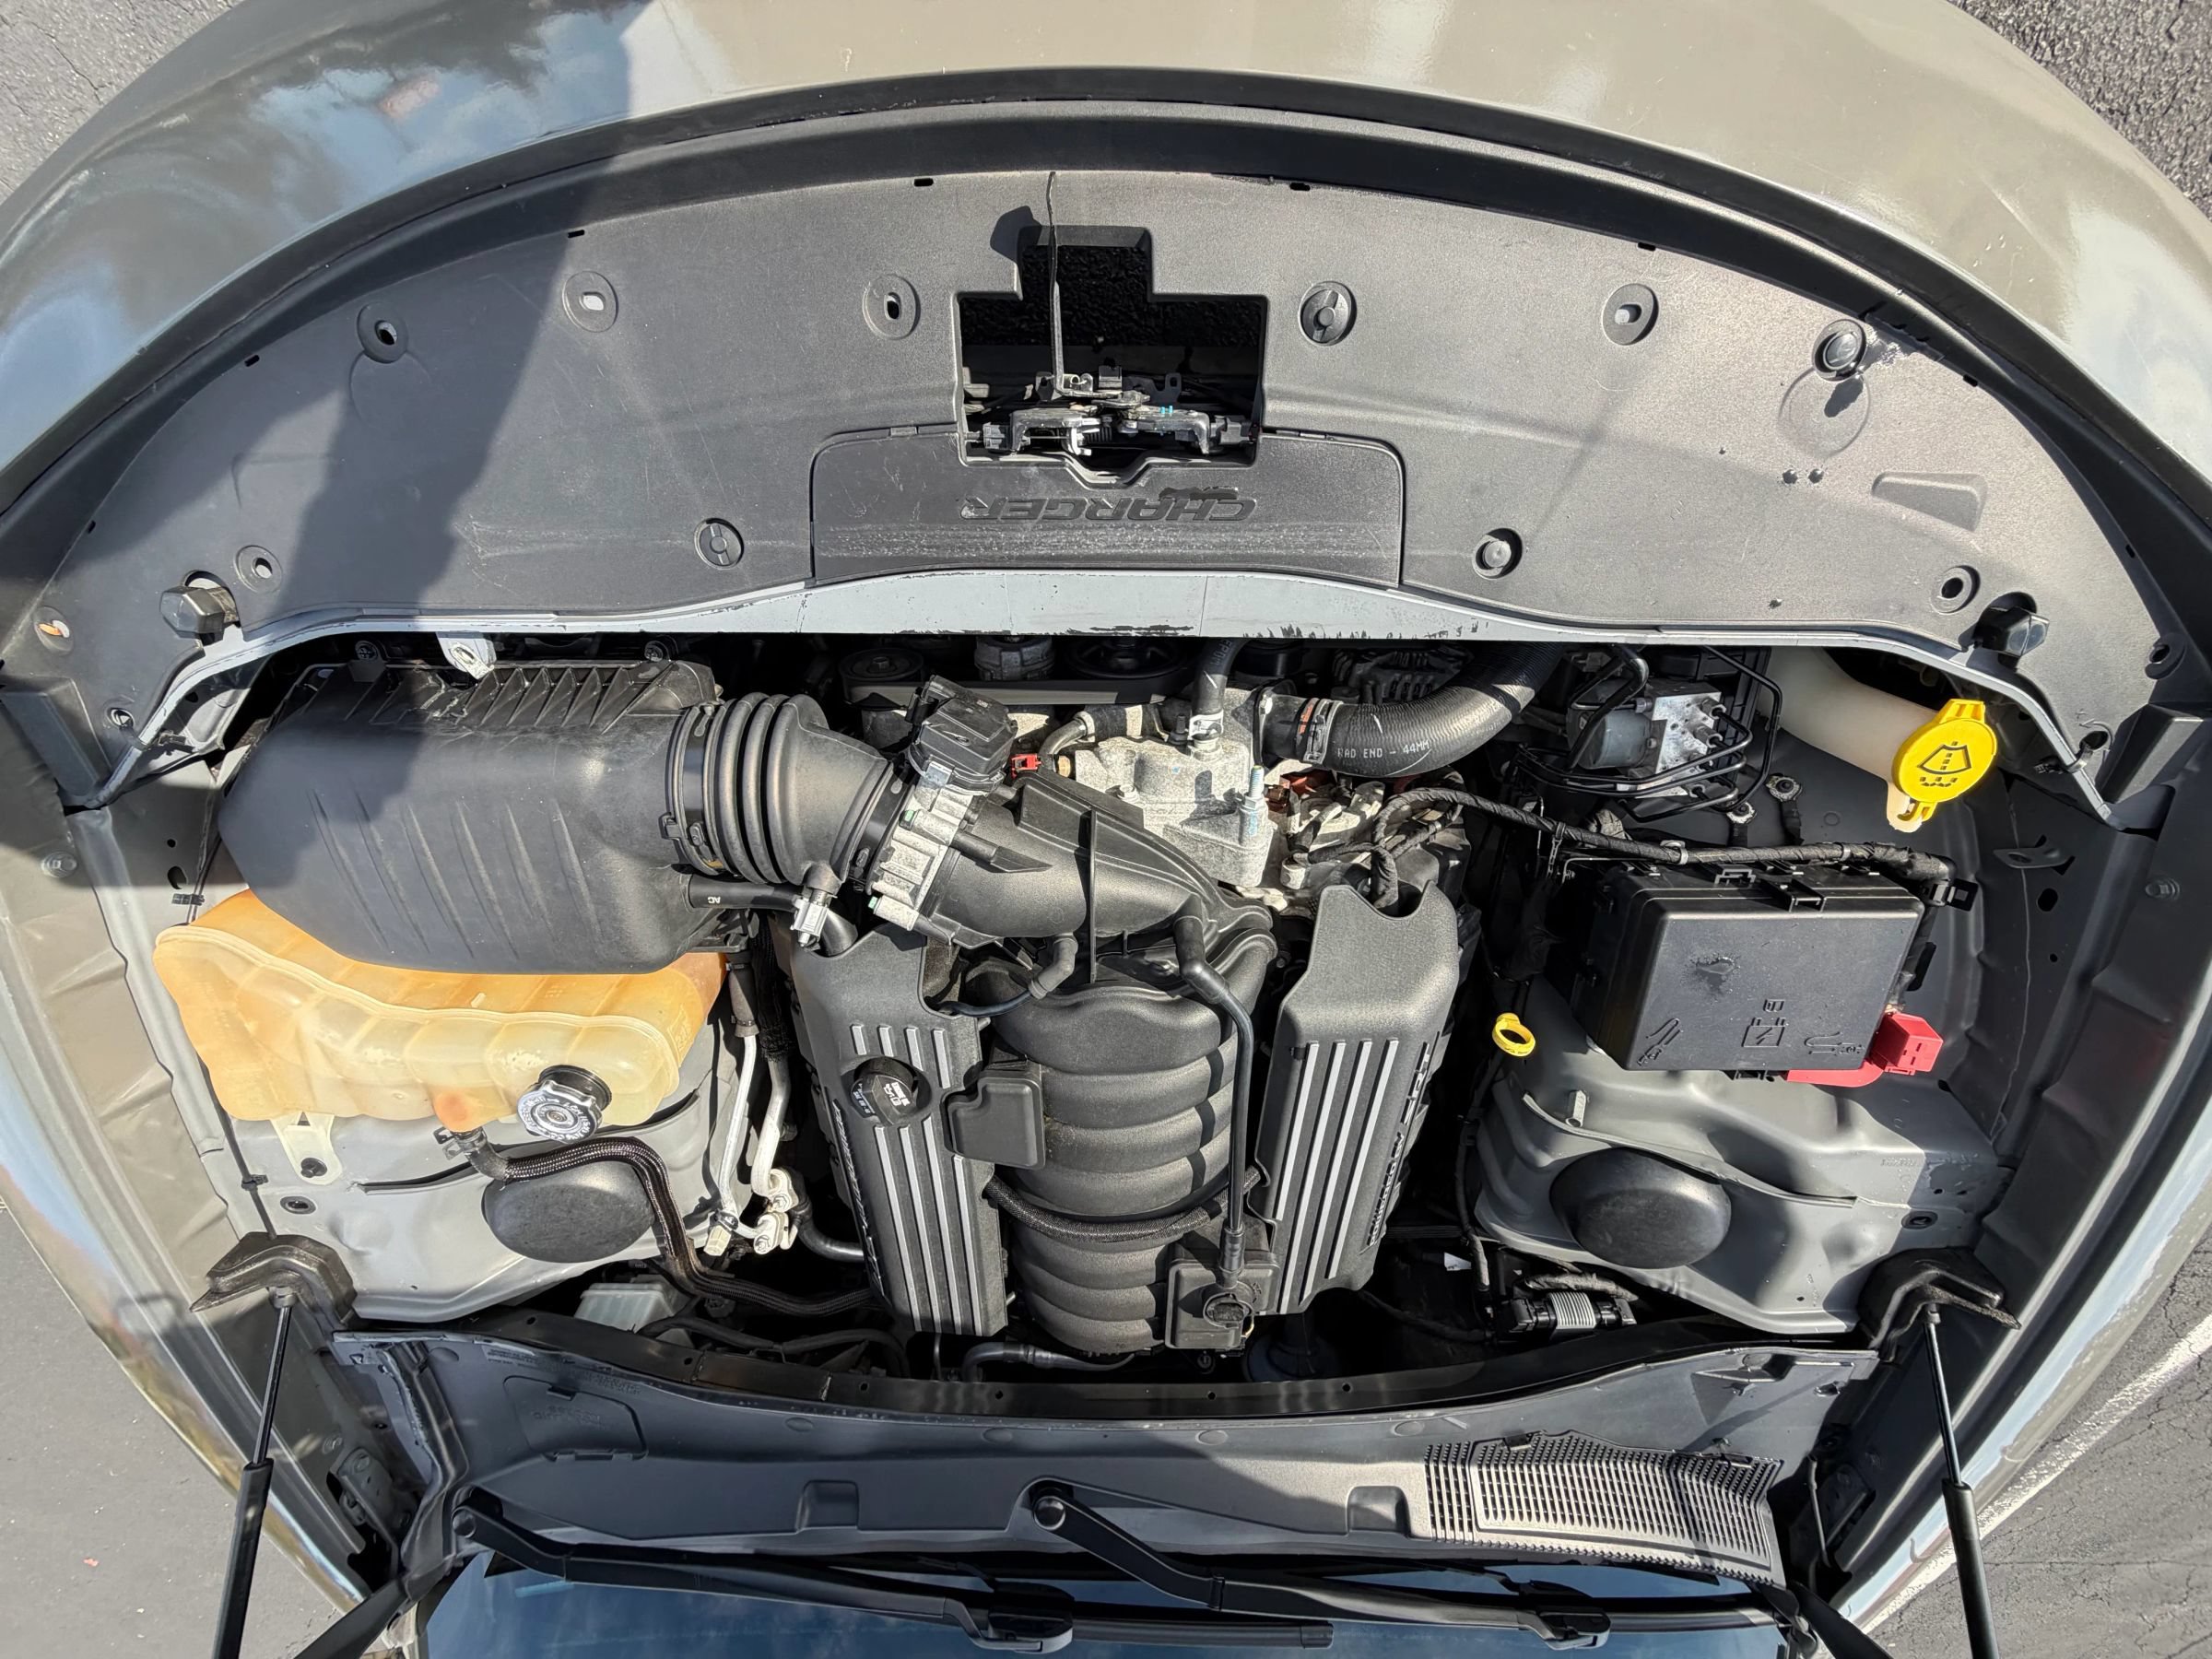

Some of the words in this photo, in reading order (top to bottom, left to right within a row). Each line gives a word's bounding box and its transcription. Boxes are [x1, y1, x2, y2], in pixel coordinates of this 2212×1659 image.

[959, 496, 1256, 522] CHARGER
[1337, 748, 1357, 759] RAD
[1363, 747, 1383, 759] END
[1402, 740, 1430, 755] 44MM
[707, 896, 721, 904] AC
[1400, 1041, 1430, 1125] SRT
